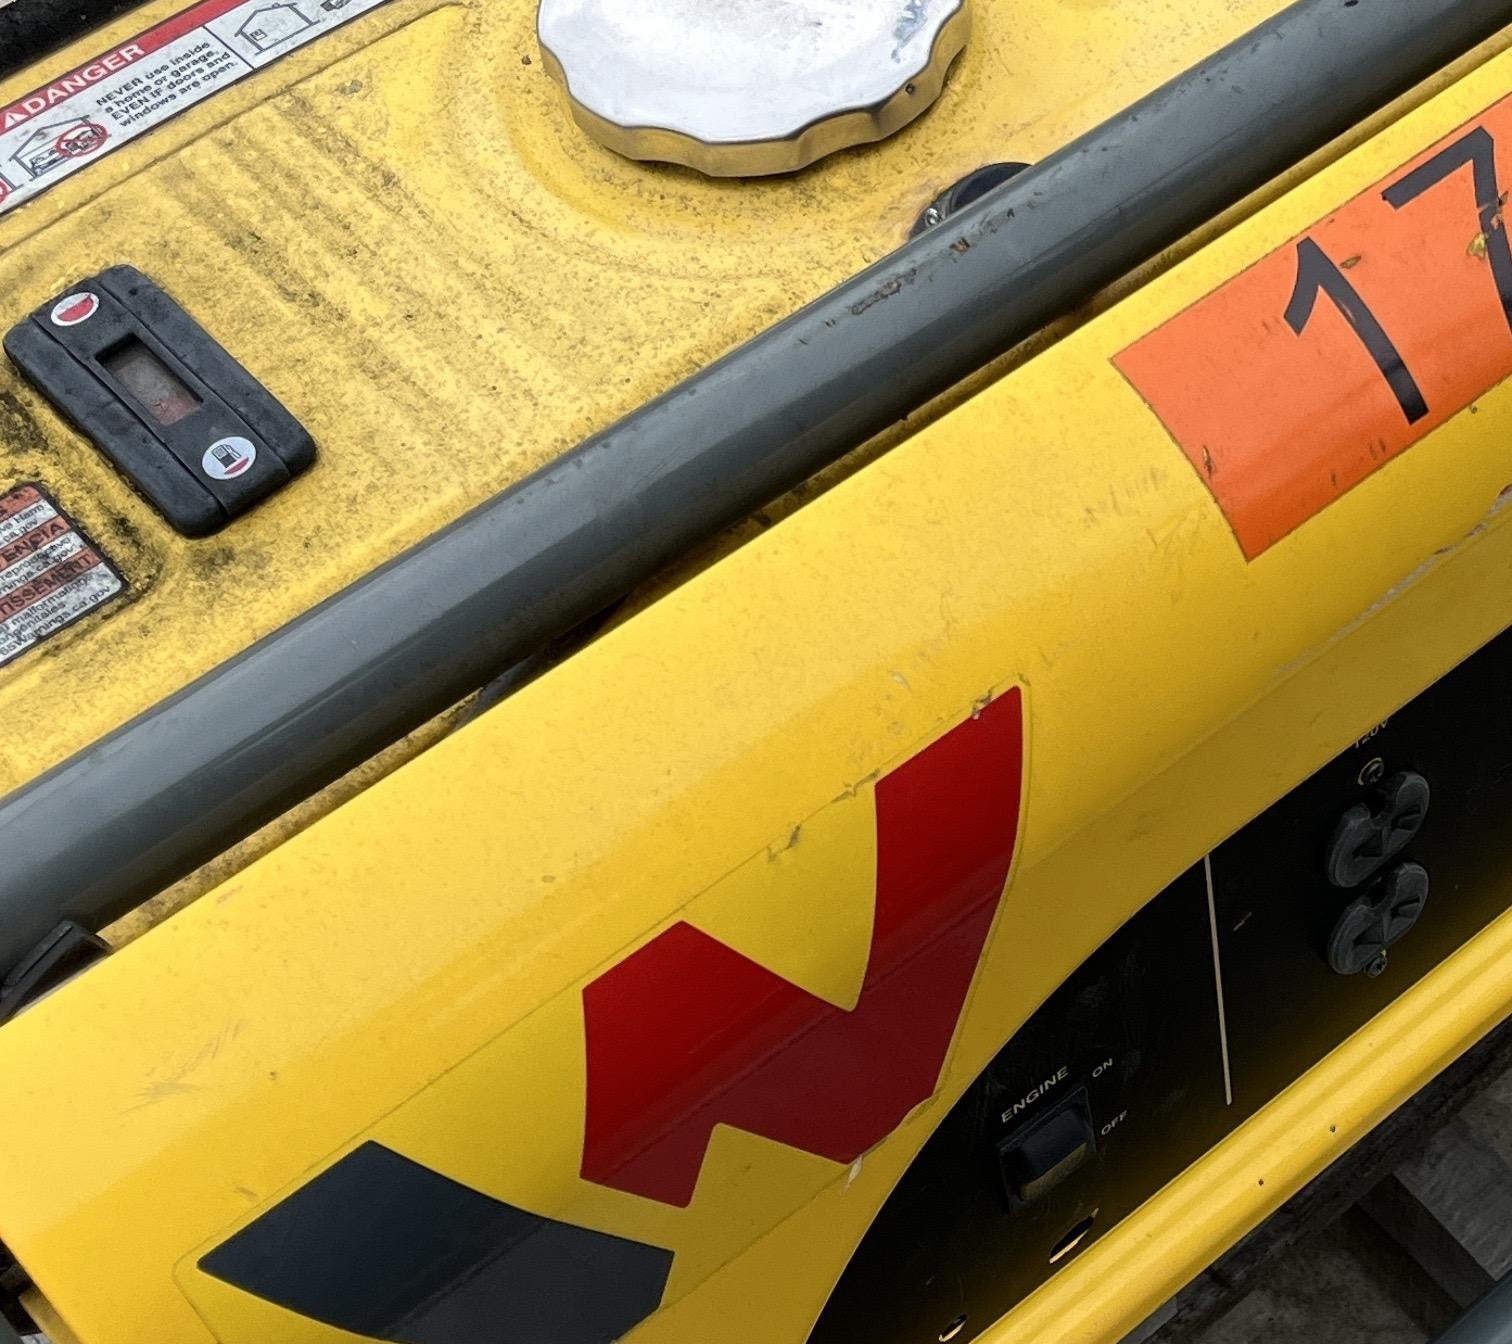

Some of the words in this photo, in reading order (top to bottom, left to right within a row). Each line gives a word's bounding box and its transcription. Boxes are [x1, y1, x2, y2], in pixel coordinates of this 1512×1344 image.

[24, 44, 145, 117] DANGER
[96, 77, 144, 107] NEVER
[146, 65, 169, 80] use
[170, 42, 210, 66] inside
[111, 97, 151, 121] EVEN
[152, 89, 164, 100] IF
[167, 69, 204, 90] doors
[206, 52, 232, 69] and
[114, 85, 153, 108] home
[120, 94, 177, 127] windows
[179, 80, 201, 94] are
[1001, 1066, 1069, 1123] ENGINE
[1092, 1058, 1113, 1078] ON
[1101, 1110, 1127, 1136] OFF
